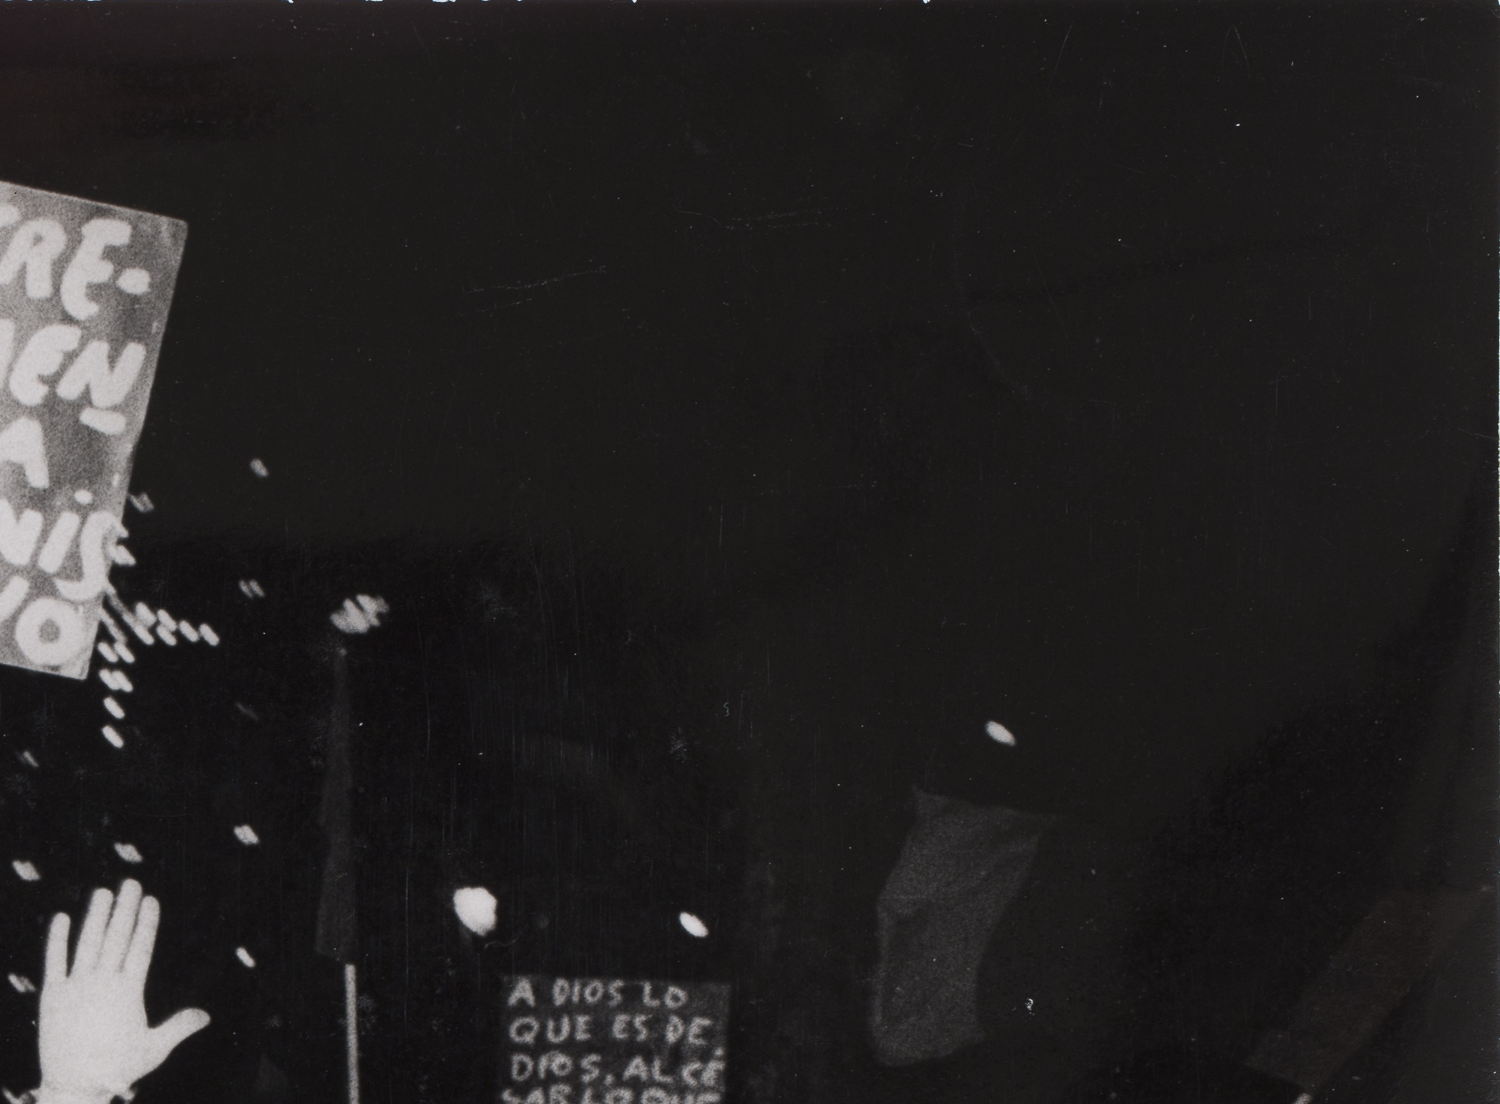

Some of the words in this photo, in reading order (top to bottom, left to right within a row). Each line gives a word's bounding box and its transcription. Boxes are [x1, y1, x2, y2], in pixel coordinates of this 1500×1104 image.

[508, 977, 536, 1008] A
[552, 977, 625, 1008] DIOS
[642, 979, 690, 1010] LO
[509, 1014, 593, 1045] QUE
[612, 1013, 653, 1043] ES
[665, 1014, 714, 1045] DE
[622, 1055, 675, 1083] AL
